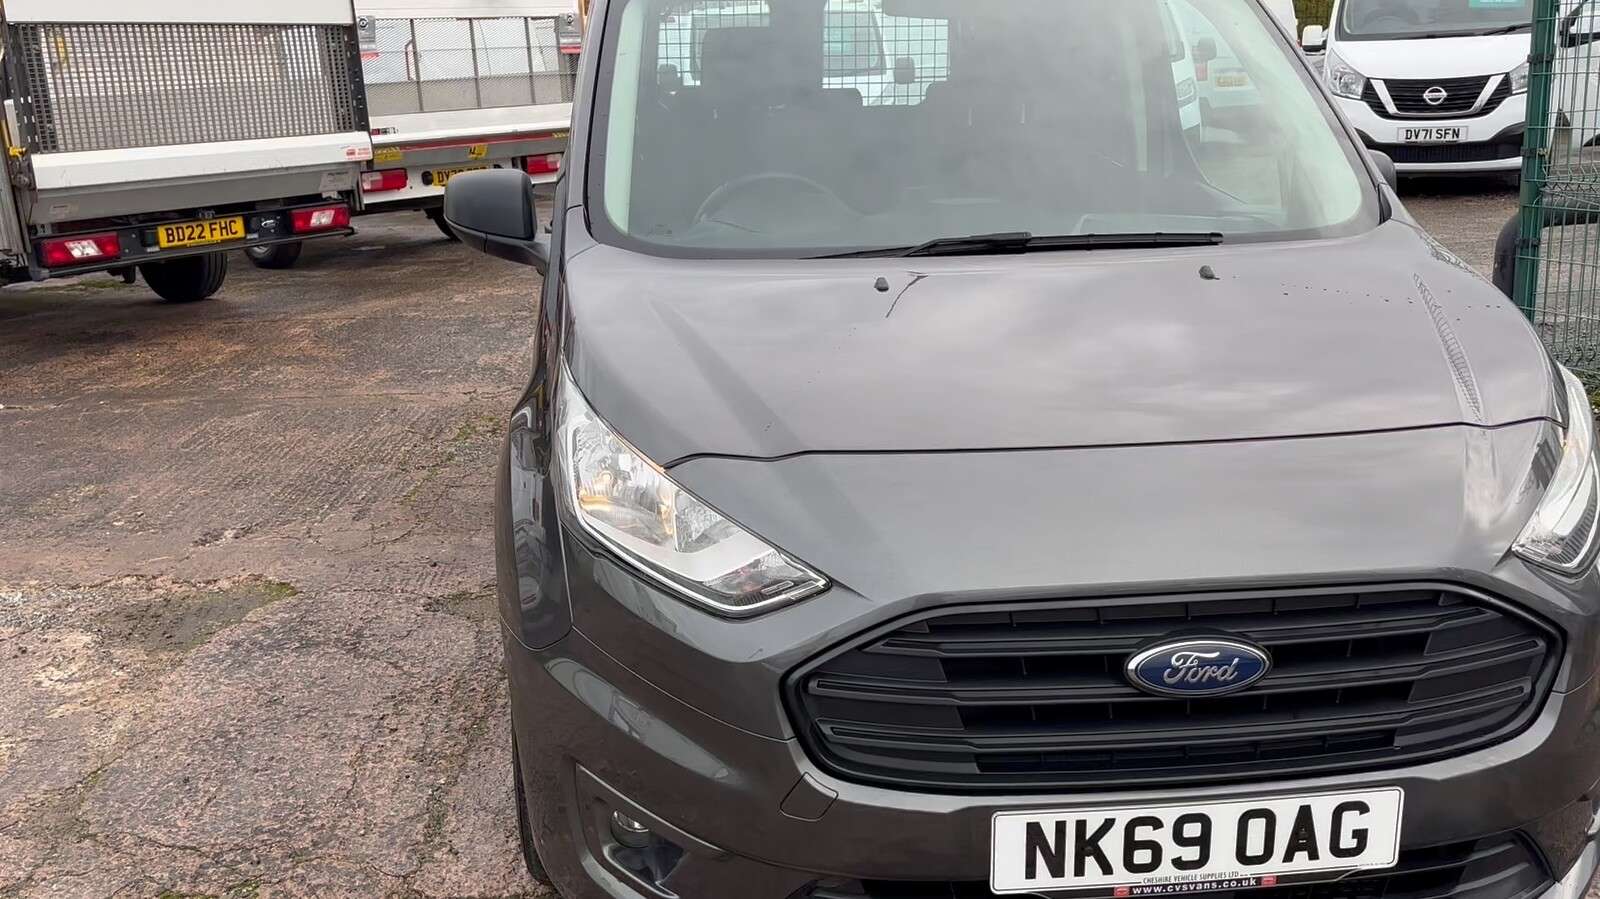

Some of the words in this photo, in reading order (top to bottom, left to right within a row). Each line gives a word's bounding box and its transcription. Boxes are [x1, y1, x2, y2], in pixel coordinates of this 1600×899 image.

[1405, 128, 1433, 140] DV71
[1435, 127, 1460, 140] SFN
[165, 223, 206, 243] BD22
[209, 219, 238, 238] FHC
[1163, 651, 1239, 684] Ford
[1024, 812, 1212, 880] NK69
[1235, 800, 1371, 866] OAG
[1132, 877, 1257, 894] www.cvsvans.co.uk
[1143, 875, 1171, 884] CHESHIRE
[1173, 873, 1197, 882] VEHICLE
[1200, 871, 1227, 880] SUPPLIES
